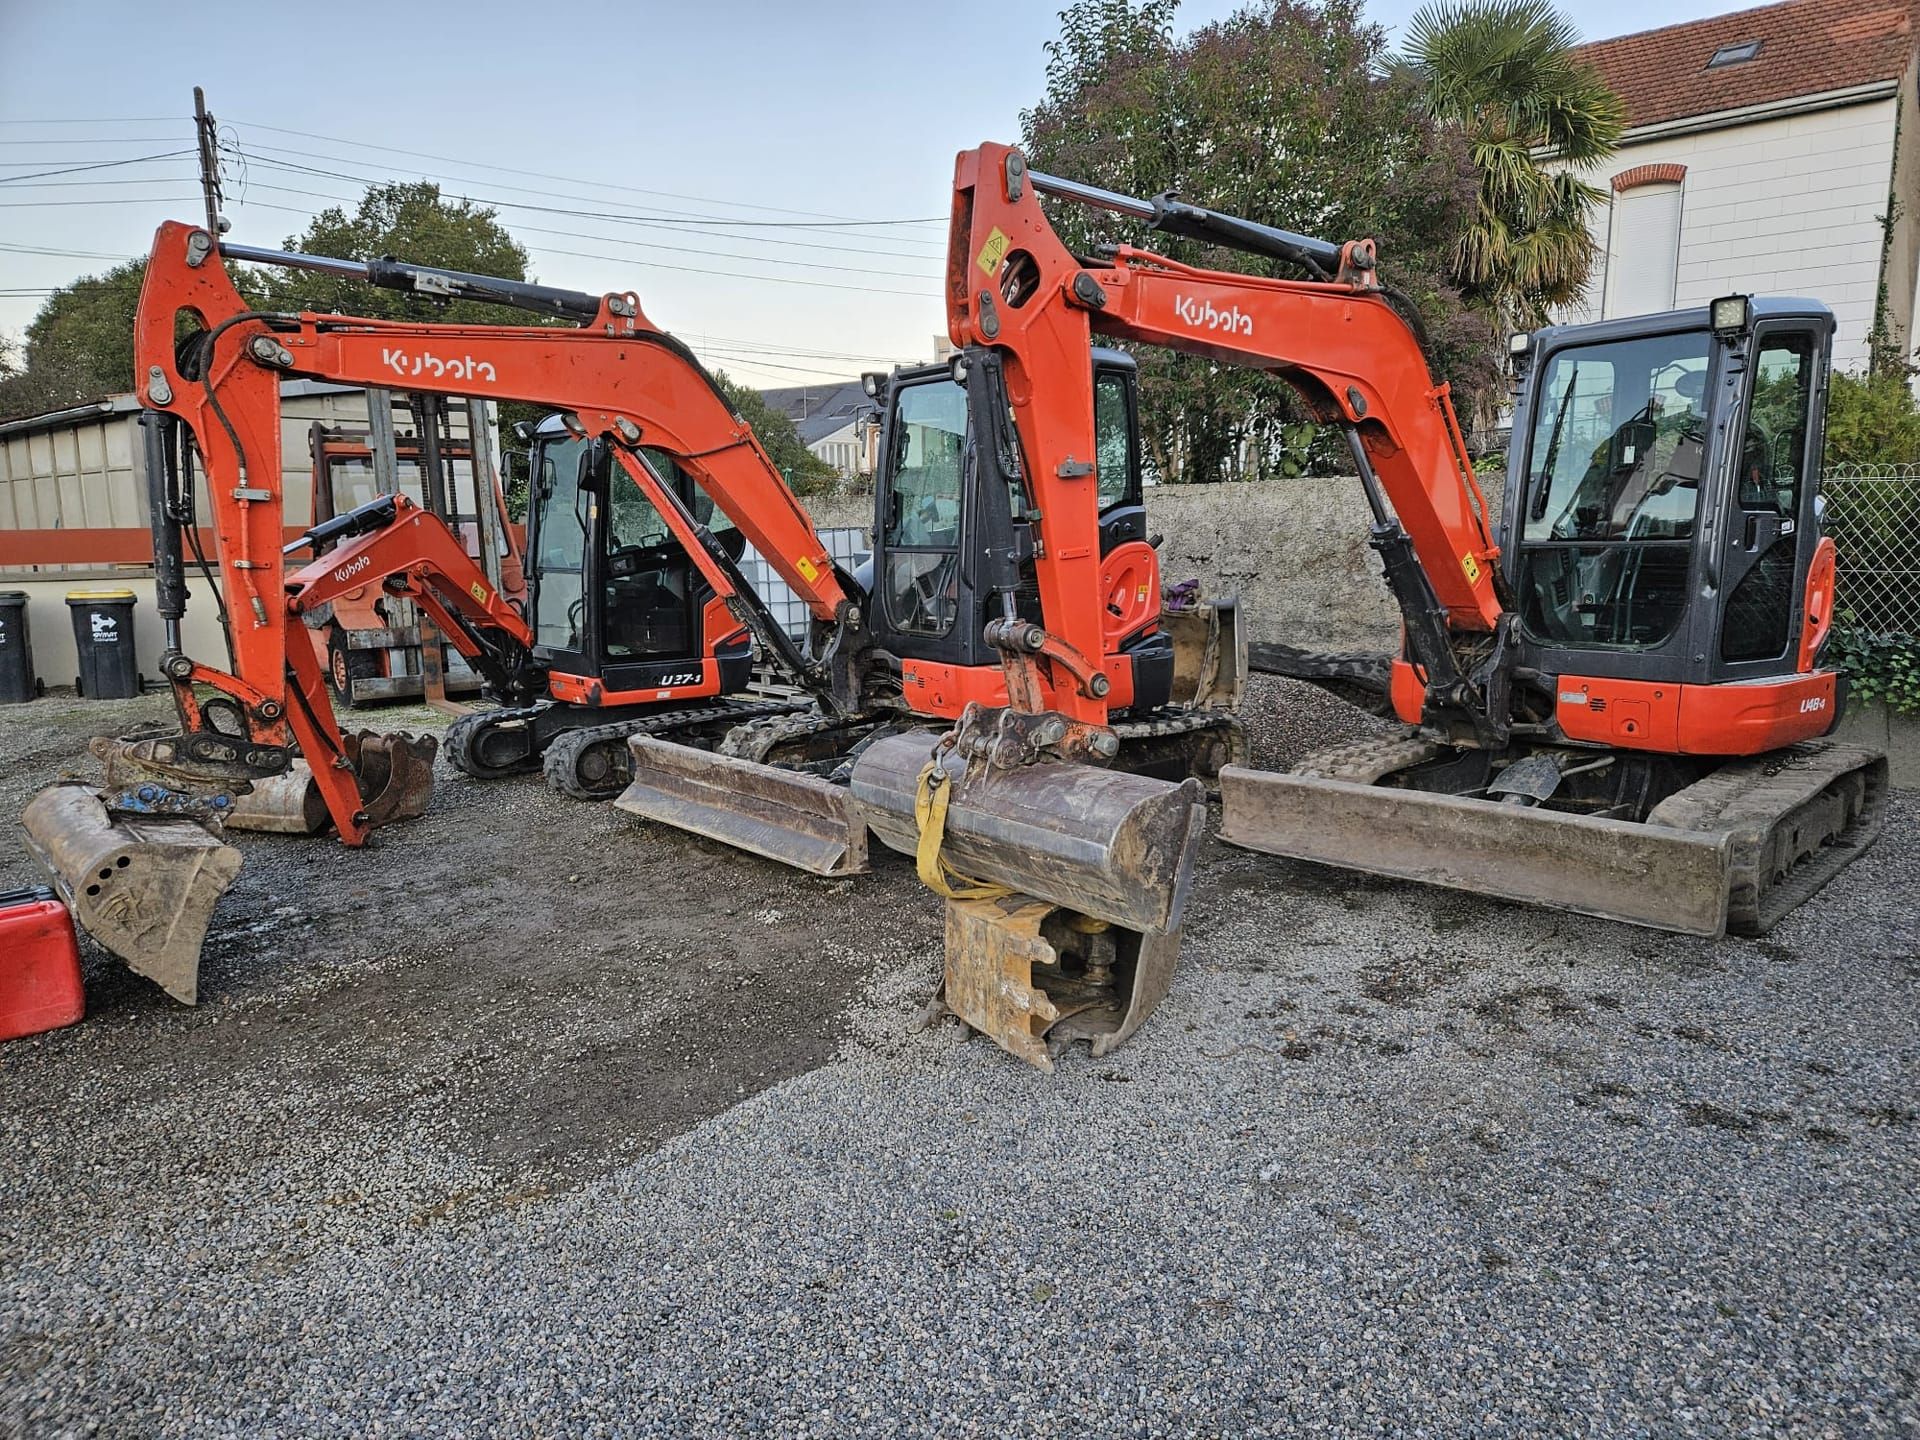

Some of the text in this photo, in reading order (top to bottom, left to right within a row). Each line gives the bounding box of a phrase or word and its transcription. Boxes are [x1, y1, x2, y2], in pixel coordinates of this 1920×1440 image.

[1175, 294, 1253, 336] Kubota
[382, 348, 497, 382] Kubota
[334, 555, 371, 582] Kubota
